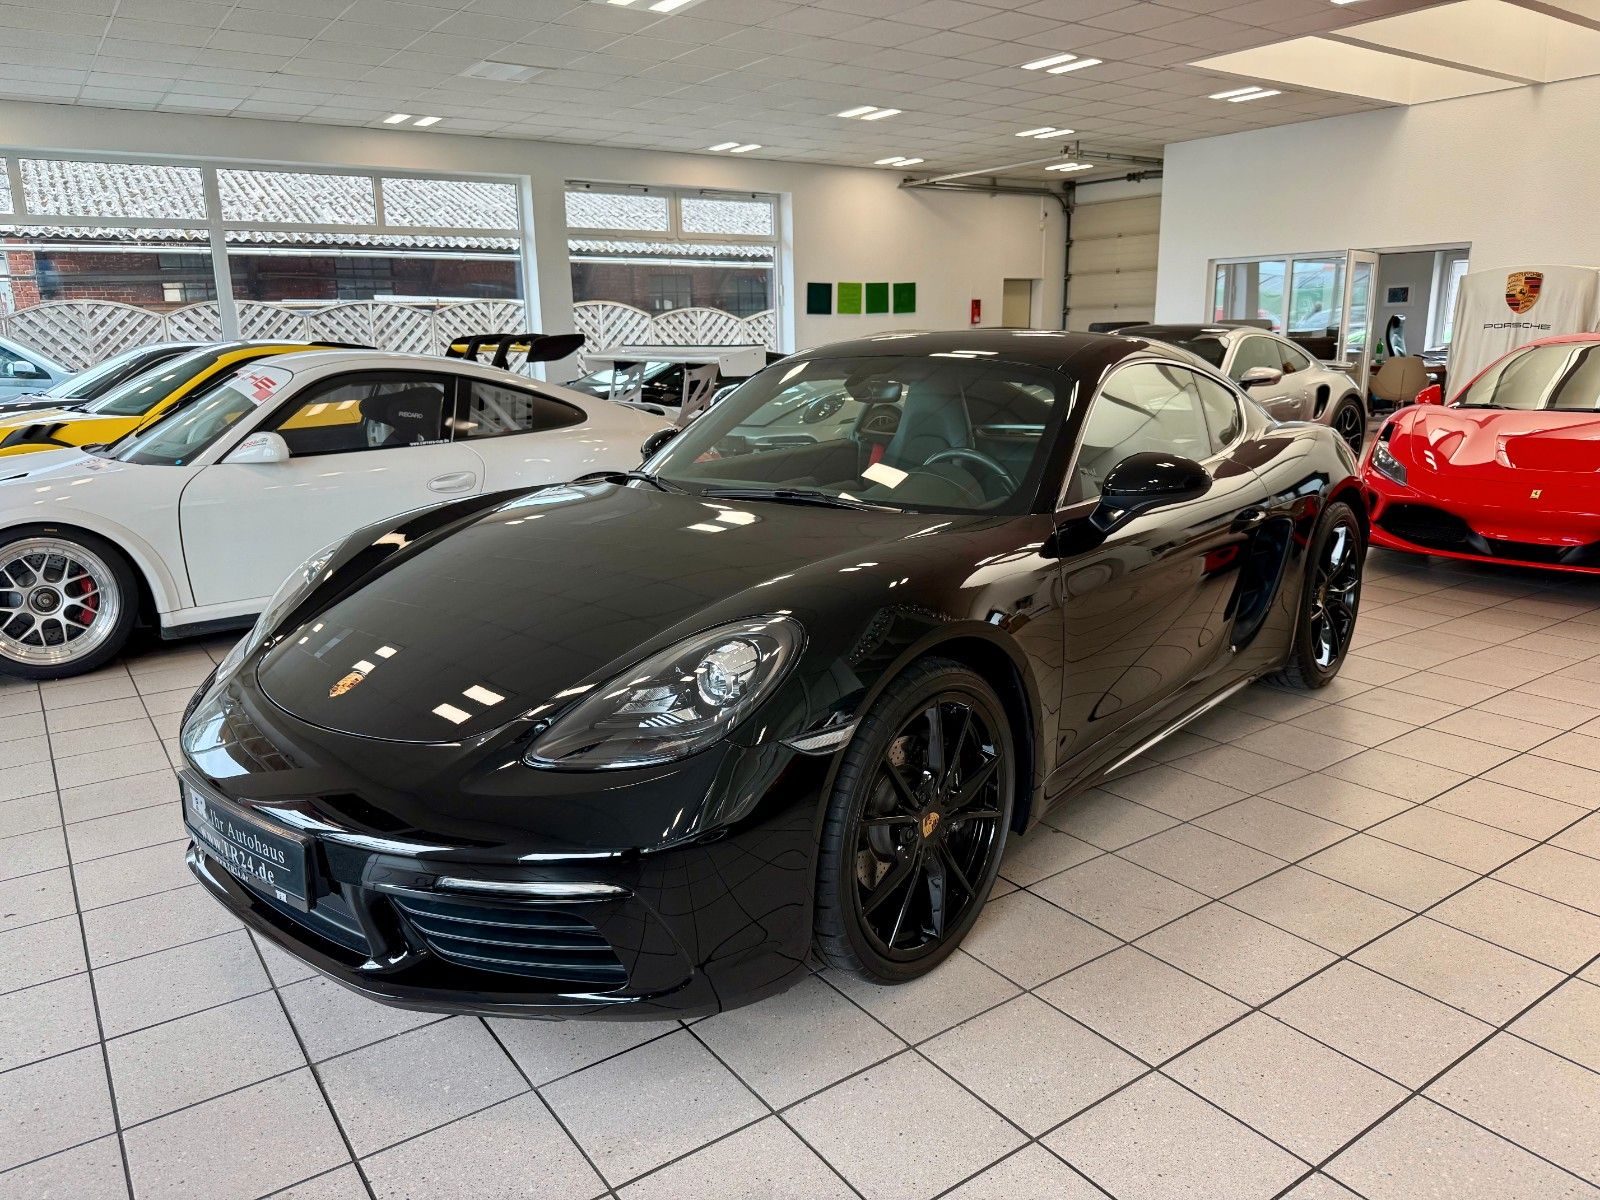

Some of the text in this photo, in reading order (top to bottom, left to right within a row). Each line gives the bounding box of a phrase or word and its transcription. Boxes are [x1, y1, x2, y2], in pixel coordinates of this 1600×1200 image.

[1483, 322, 1552, 330] PORSCHE
[398, 411, 424, 419] RECARO
[209, 808, 224, 832] Ihr
[227, 821, 285, 864] Autohaus
[200, 826, 275, 884] www.TR24.de
